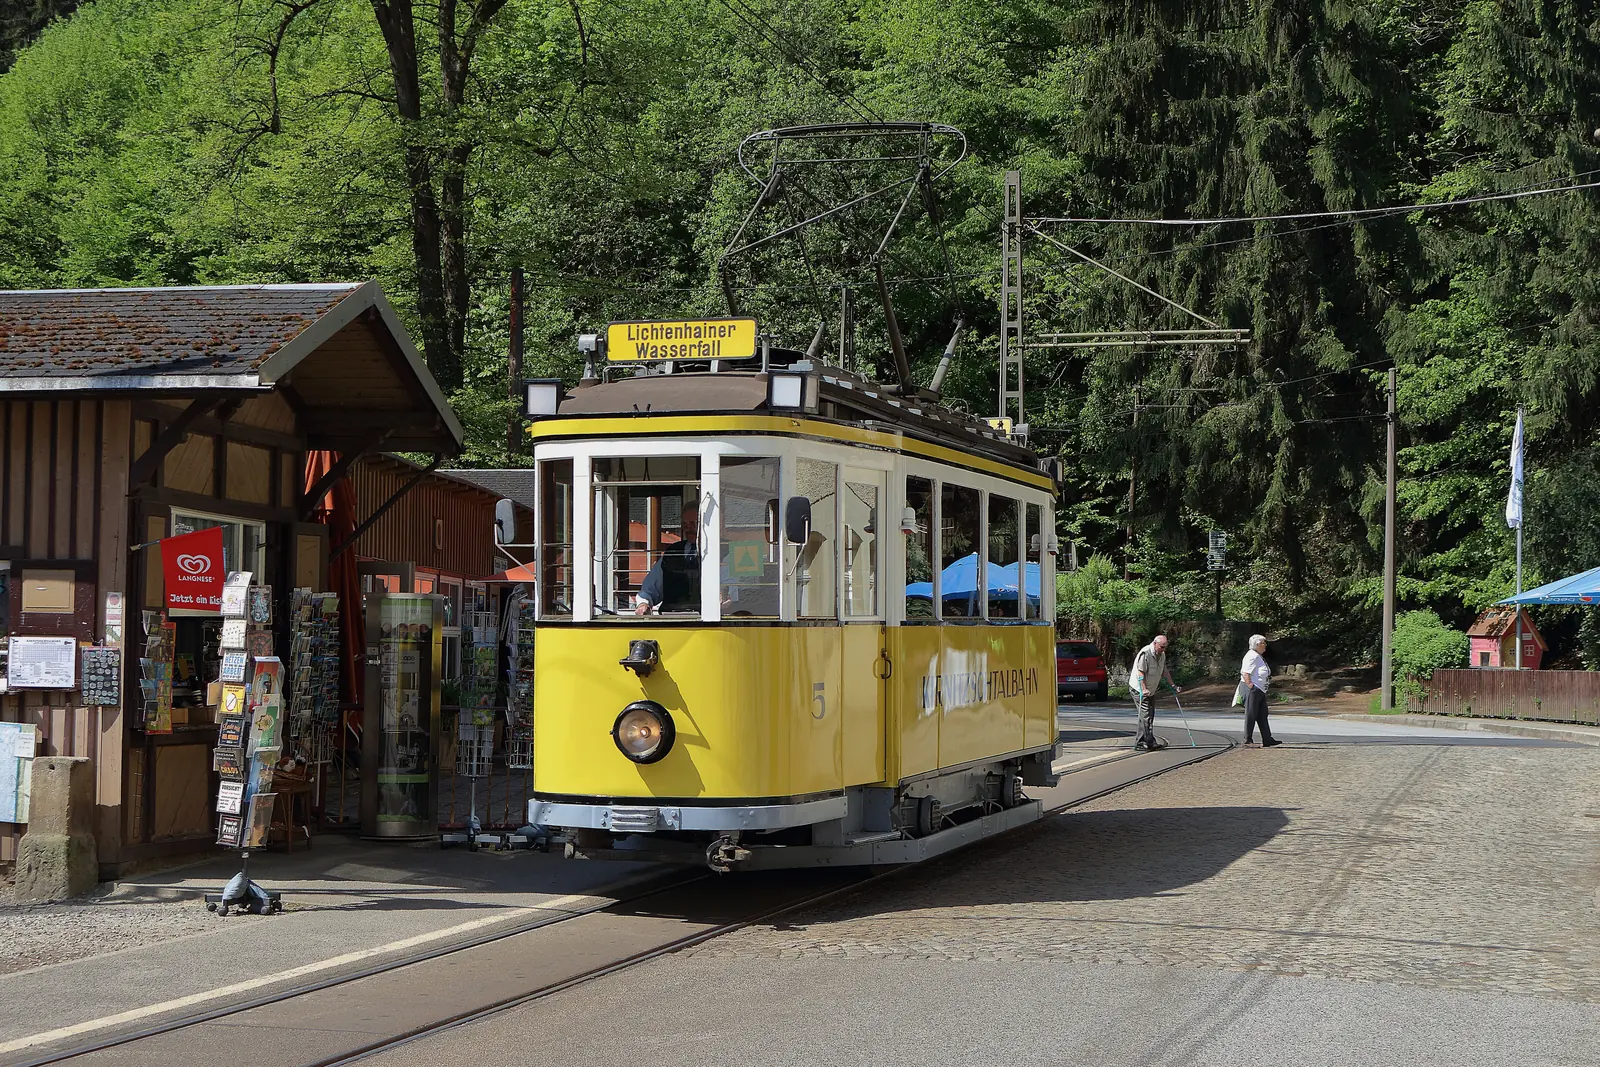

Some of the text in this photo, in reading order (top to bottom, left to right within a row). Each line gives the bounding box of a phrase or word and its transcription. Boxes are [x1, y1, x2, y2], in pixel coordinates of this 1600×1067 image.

[627, 323, 736, 341] Lichtenhainer
[635, 340, 721, 359] Wasserfall
[178, 575, 213, 583] LANGNESE
[170, 593, 194, 603] Jetzt
[196, 594, 207, 604] ein
[811, 682, 826, 720] 5
